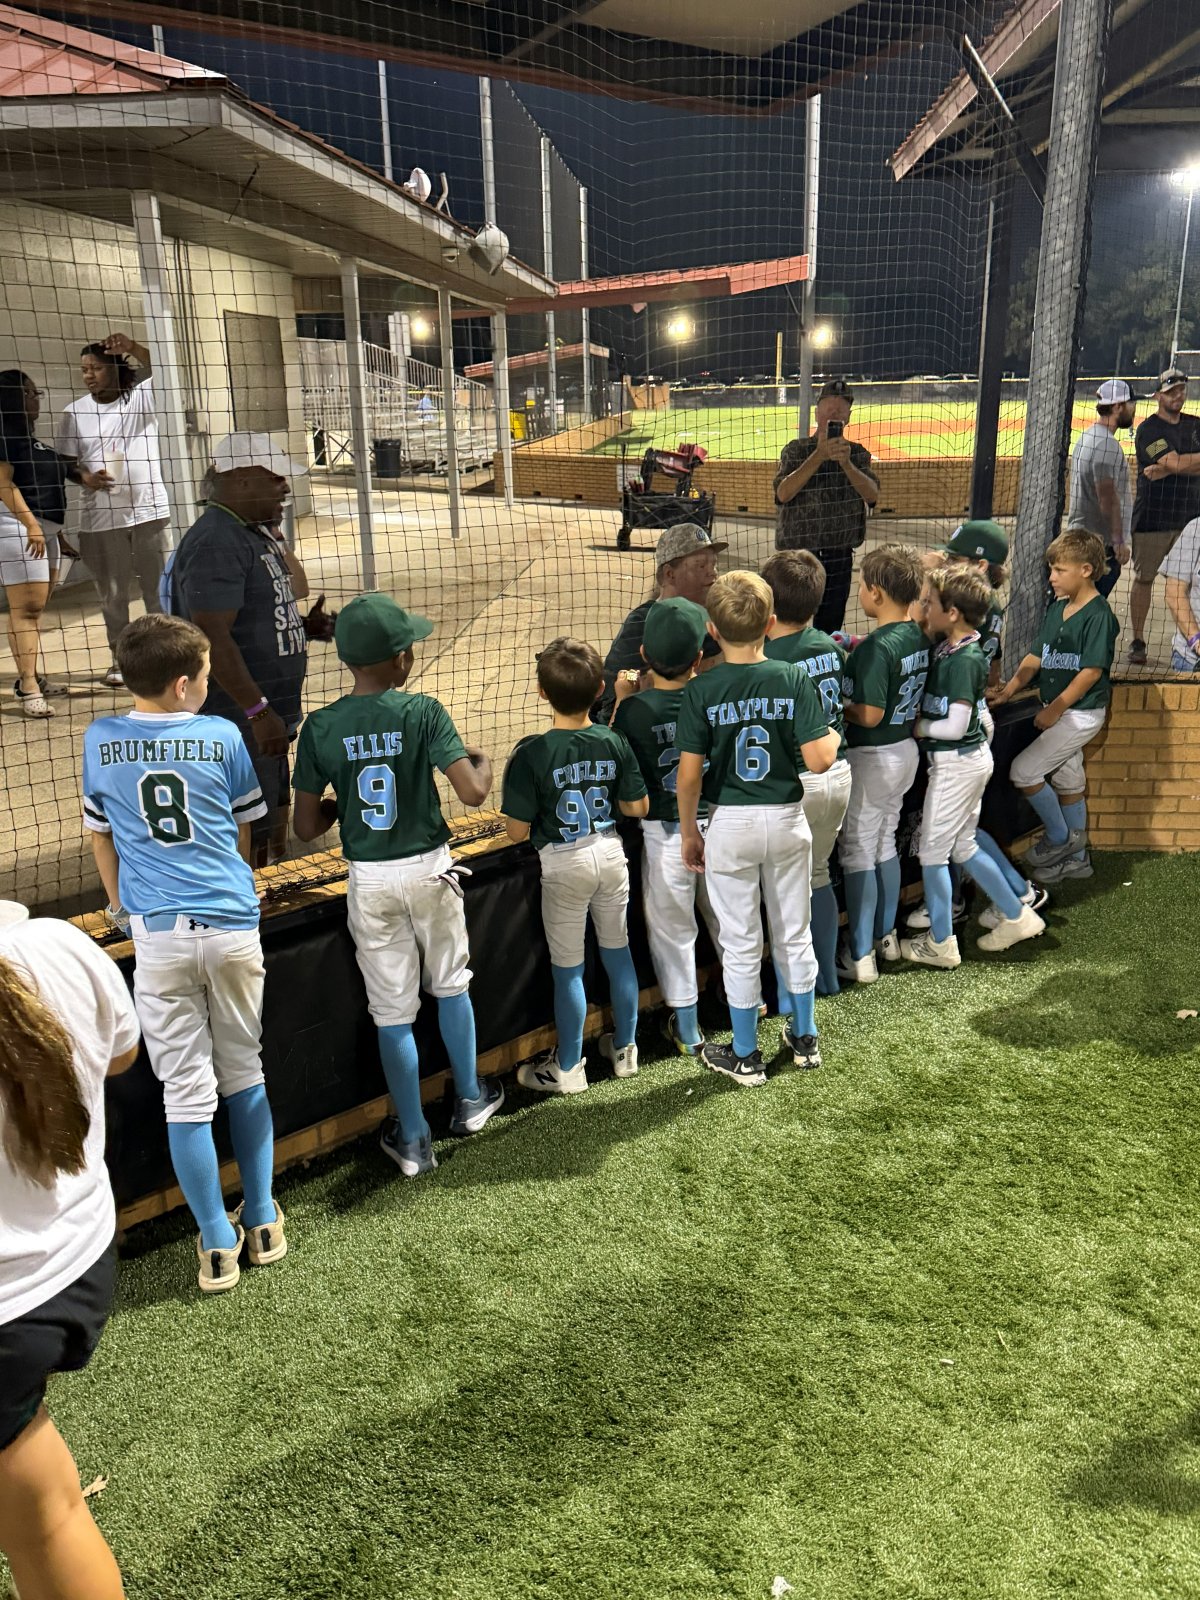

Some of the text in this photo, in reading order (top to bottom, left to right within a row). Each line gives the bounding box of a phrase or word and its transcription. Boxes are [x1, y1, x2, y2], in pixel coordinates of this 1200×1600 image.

[98, 738, 225, 767] BRUMFIELD
[343, 731, 403, 761] ELLIS
[735, 724, 771, 782] 6
[137, 769, 195, 848] 8
[357, 764, 398, 830] 9
